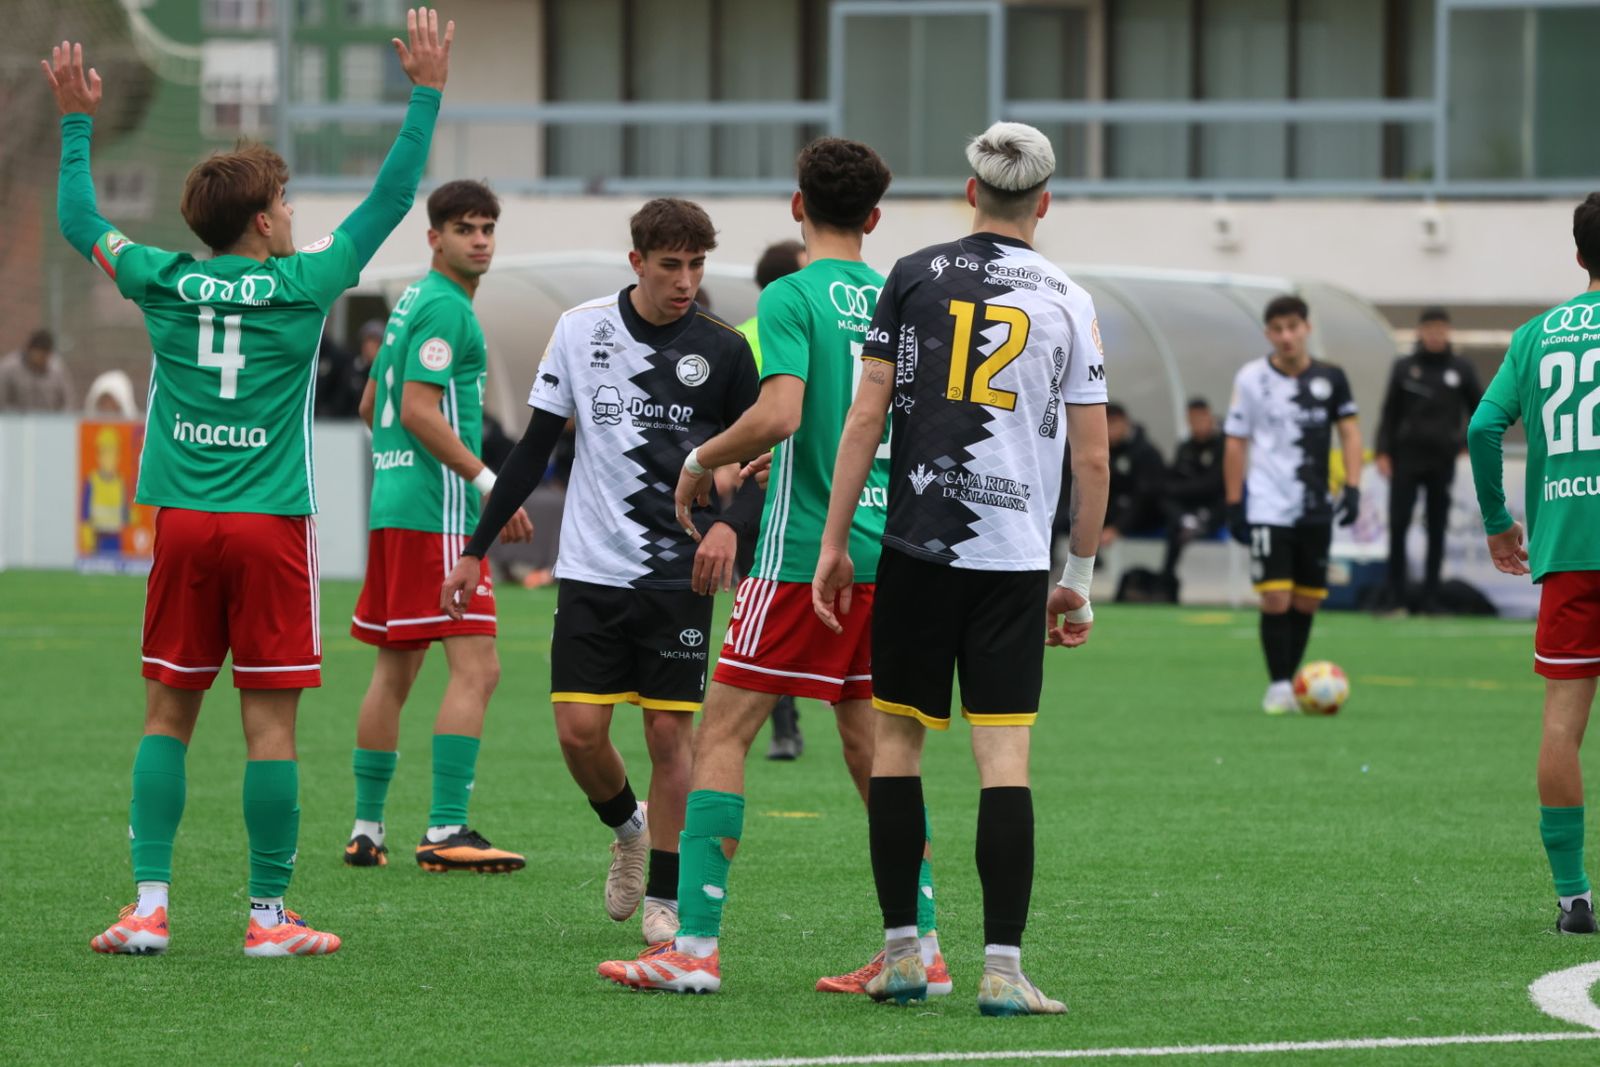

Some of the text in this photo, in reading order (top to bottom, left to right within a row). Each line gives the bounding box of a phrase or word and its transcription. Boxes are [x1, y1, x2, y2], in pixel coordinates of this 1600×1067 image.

[955, 256, 979, 271] De
[984, 261, 1042, 283] Castro
[983, 276, 1038, 292] ABOGADOS
[197, 305, 246, 398] 4
[896, 324, 906, 388] TERNERA
[904, 325, 916, 384] CHARRA
[946, 299, 1031, 412] 12
[631, 397, 694, 424] Don QR
[1539, 347, 1600, 457] 22
[173, 413, 268, 448] inacua
[944, 470, 983, 490] CAJA
[1544, 475, 1600, 501] inacu
[942, 486, 1029, 514] DE SALAMANC
